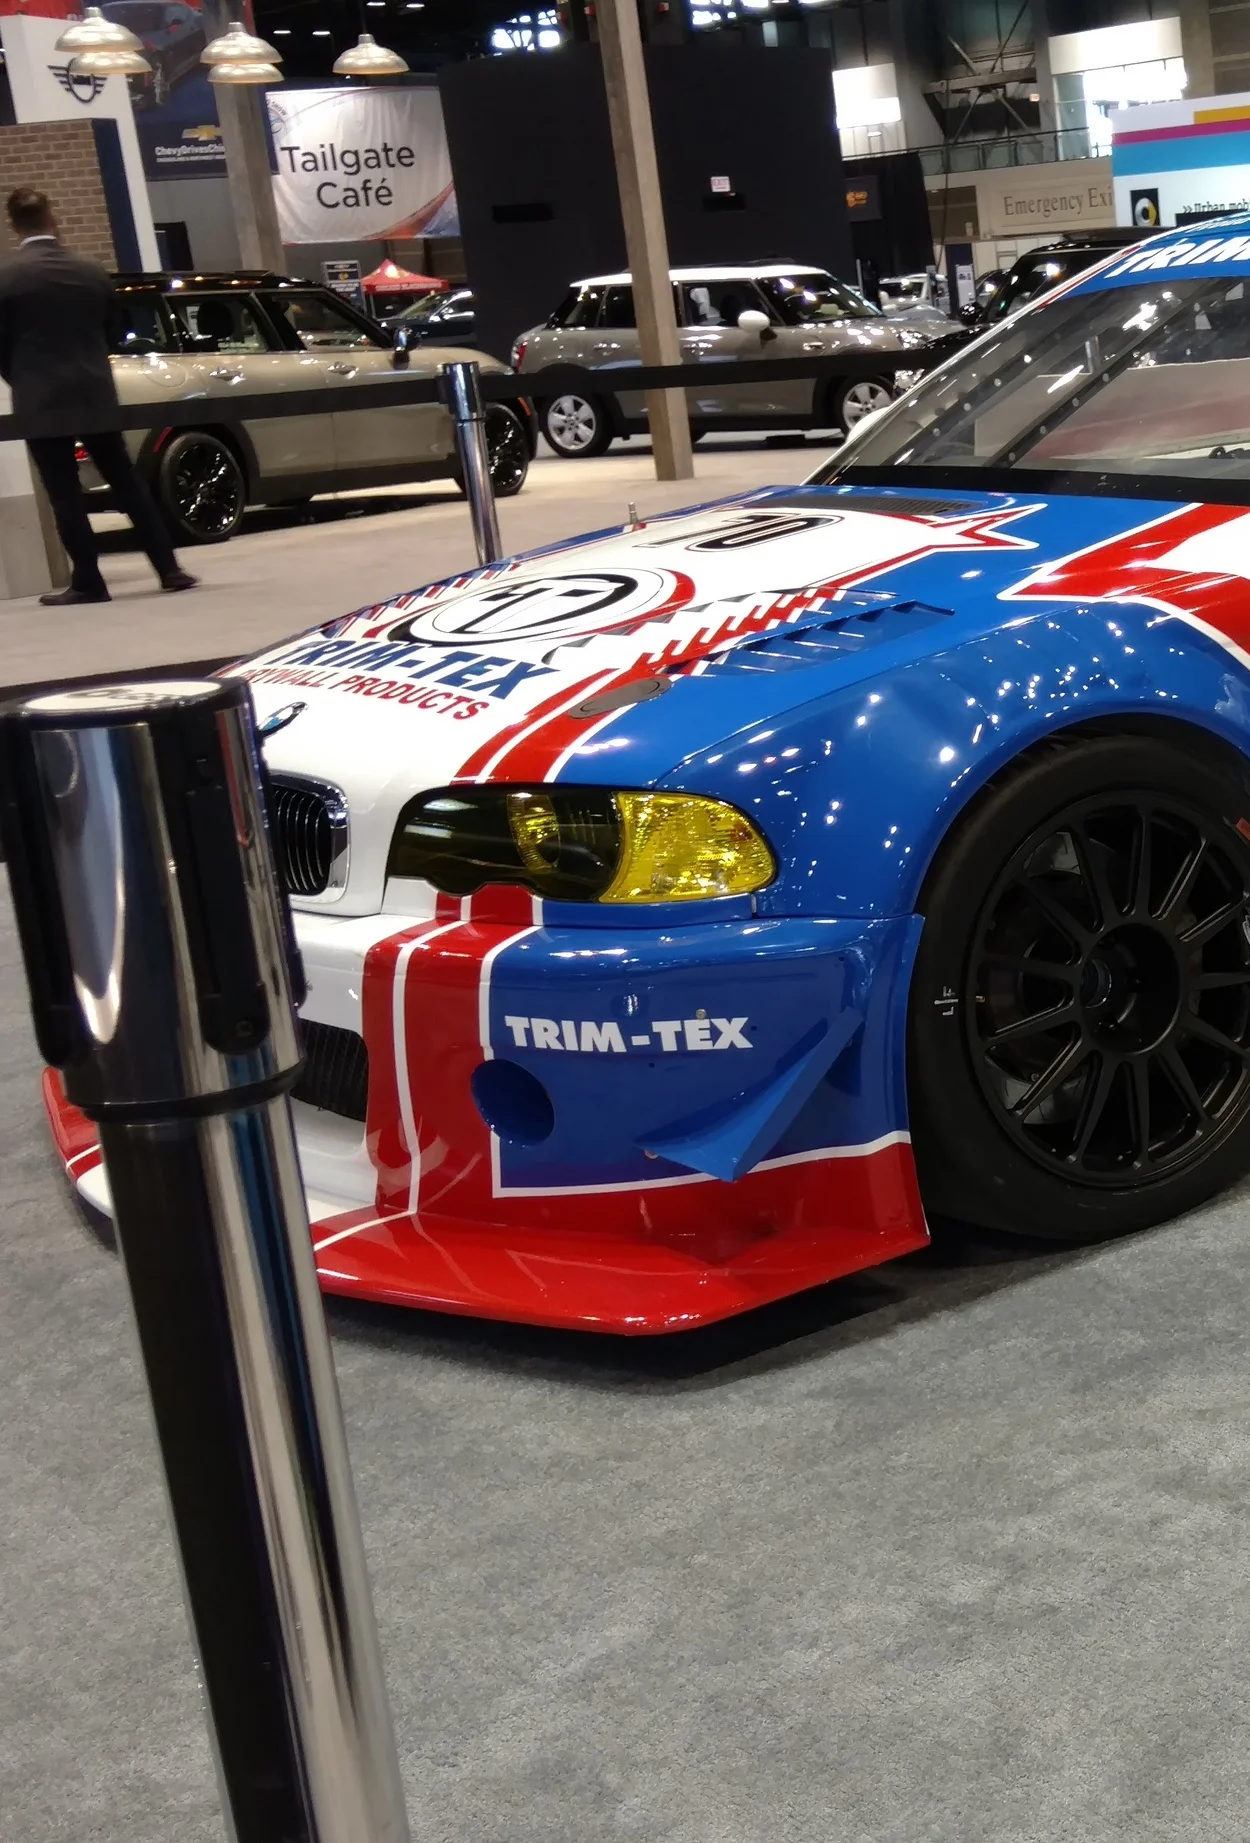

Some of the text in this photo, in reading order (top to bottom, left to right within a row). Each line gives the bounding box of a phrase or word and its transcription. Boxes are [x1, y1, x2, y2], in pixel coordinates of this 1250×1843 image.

[280, 142, 415, 176] Tailgate
[317, 177, 393, 209] Café
[1003, 186, 1113, 218] Emergency Exi
[262, 640, 560, 700] TRIM-TEX
[328, 674, 489, 720] PRODUCTS
[504, 1015, 754, 1053] TRIM-TEX
